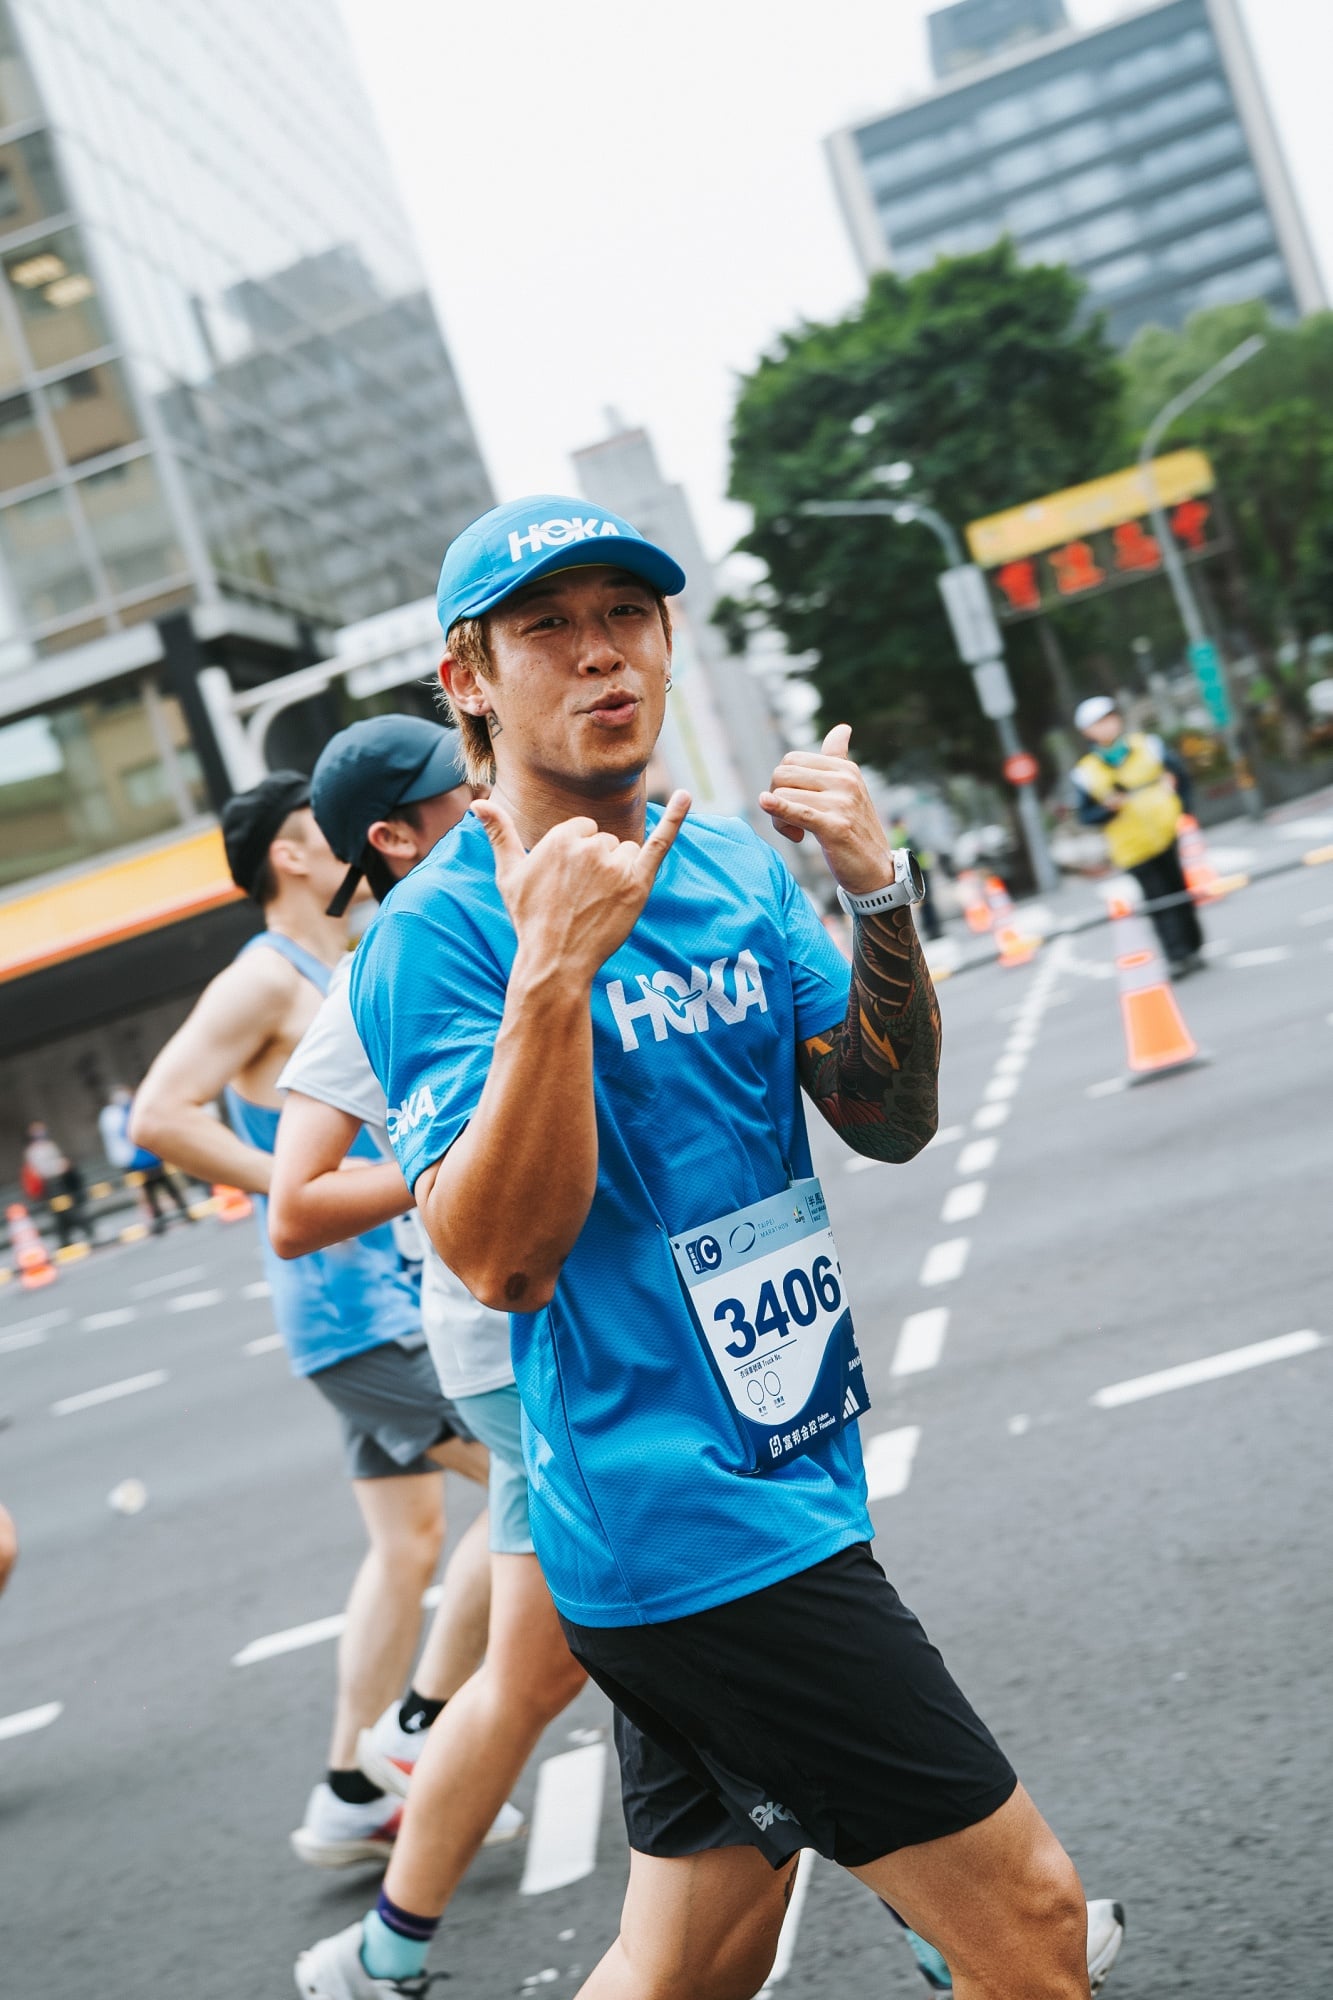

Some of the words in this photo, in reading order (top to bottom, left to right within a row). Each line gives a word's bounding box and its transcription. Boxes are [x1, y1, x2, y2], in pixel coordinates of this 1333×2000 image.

[508, 517, 620, 563] HOKA
[606, 949, 768, 1052] HOKA
[387, 1085, 436, 1144] OKA
[758, 1218, 775, 1229] TAIPEI
[760, 1222, 789, 1238] MARATHON
[700, 1239, 718, 1264] C
[713, 1255, 841, 1358] 3406
[762, 1357, 774, 1367] Truck
[782, 1420, 818, 1451] 富邦金控
[819, 1416, 836, 1430] Financial
